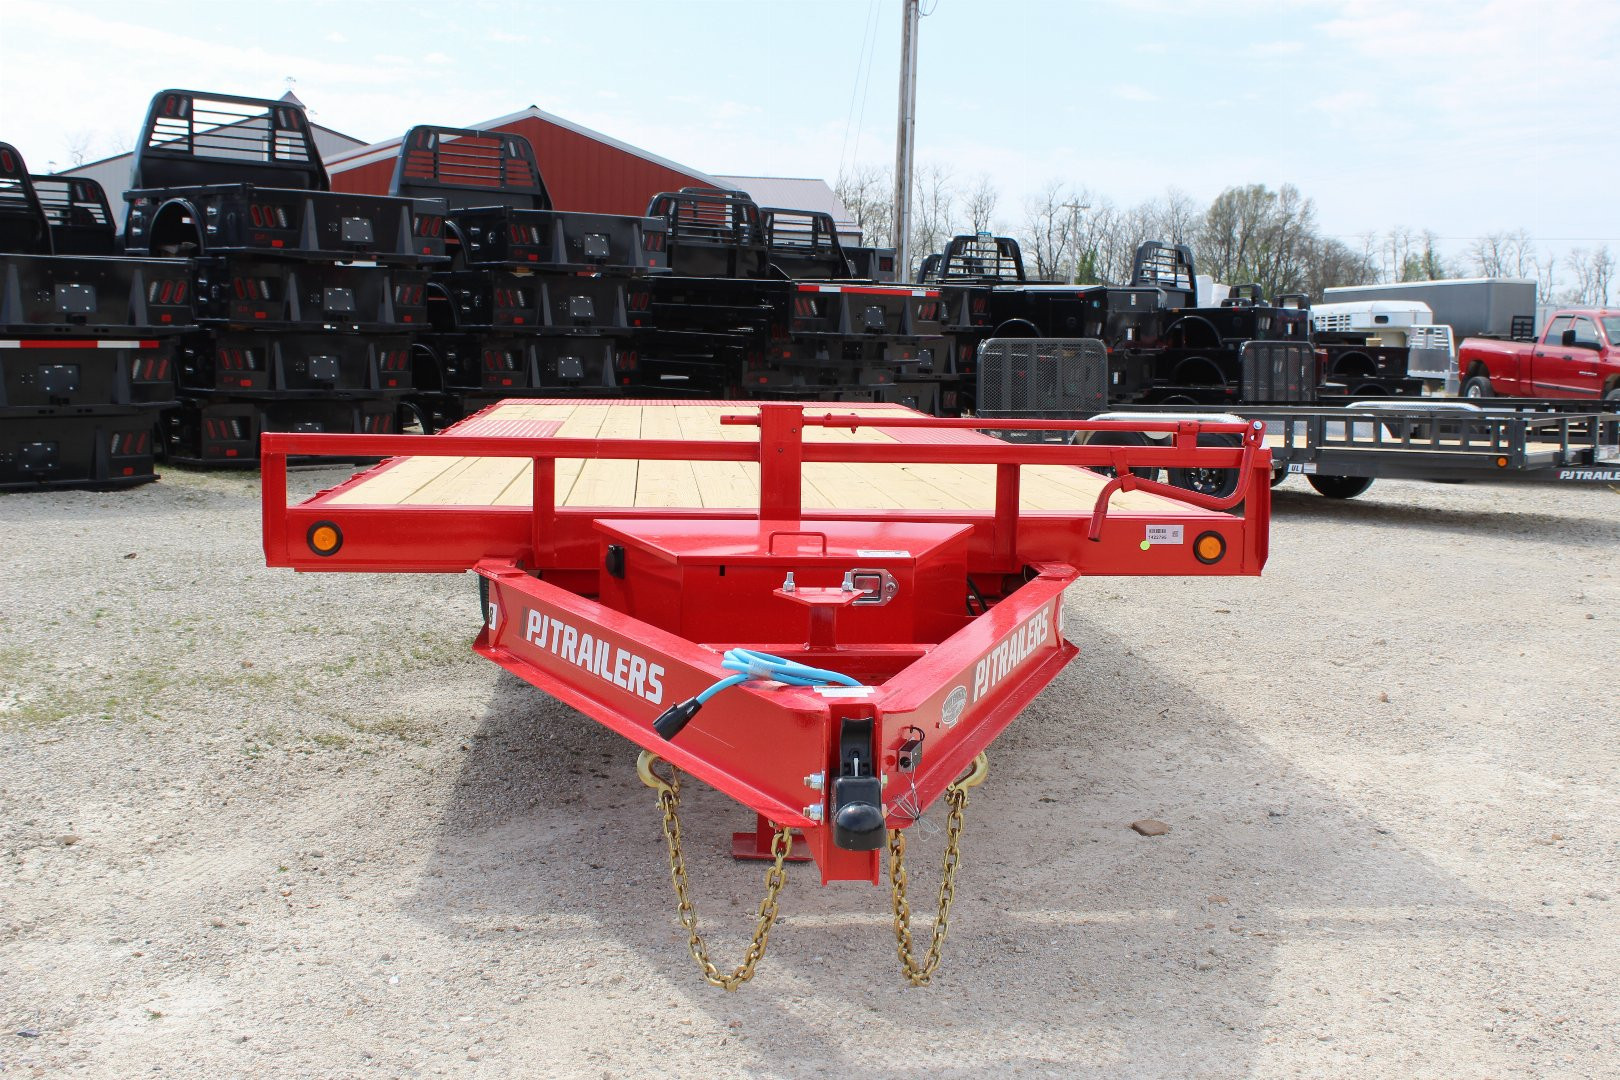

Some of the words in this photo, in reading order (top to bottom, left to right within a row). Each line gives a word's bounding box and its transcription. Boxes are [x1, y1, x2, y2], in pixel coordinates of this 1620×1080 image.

[1560, 470, 1575, 480] PJ
[527, 608, 549, 649] PJ
[550, 619, 665, 706] TRAILERS
[973, 655, 992, 703] PJ
[992, 606, 1049, 686] TRAILERS
